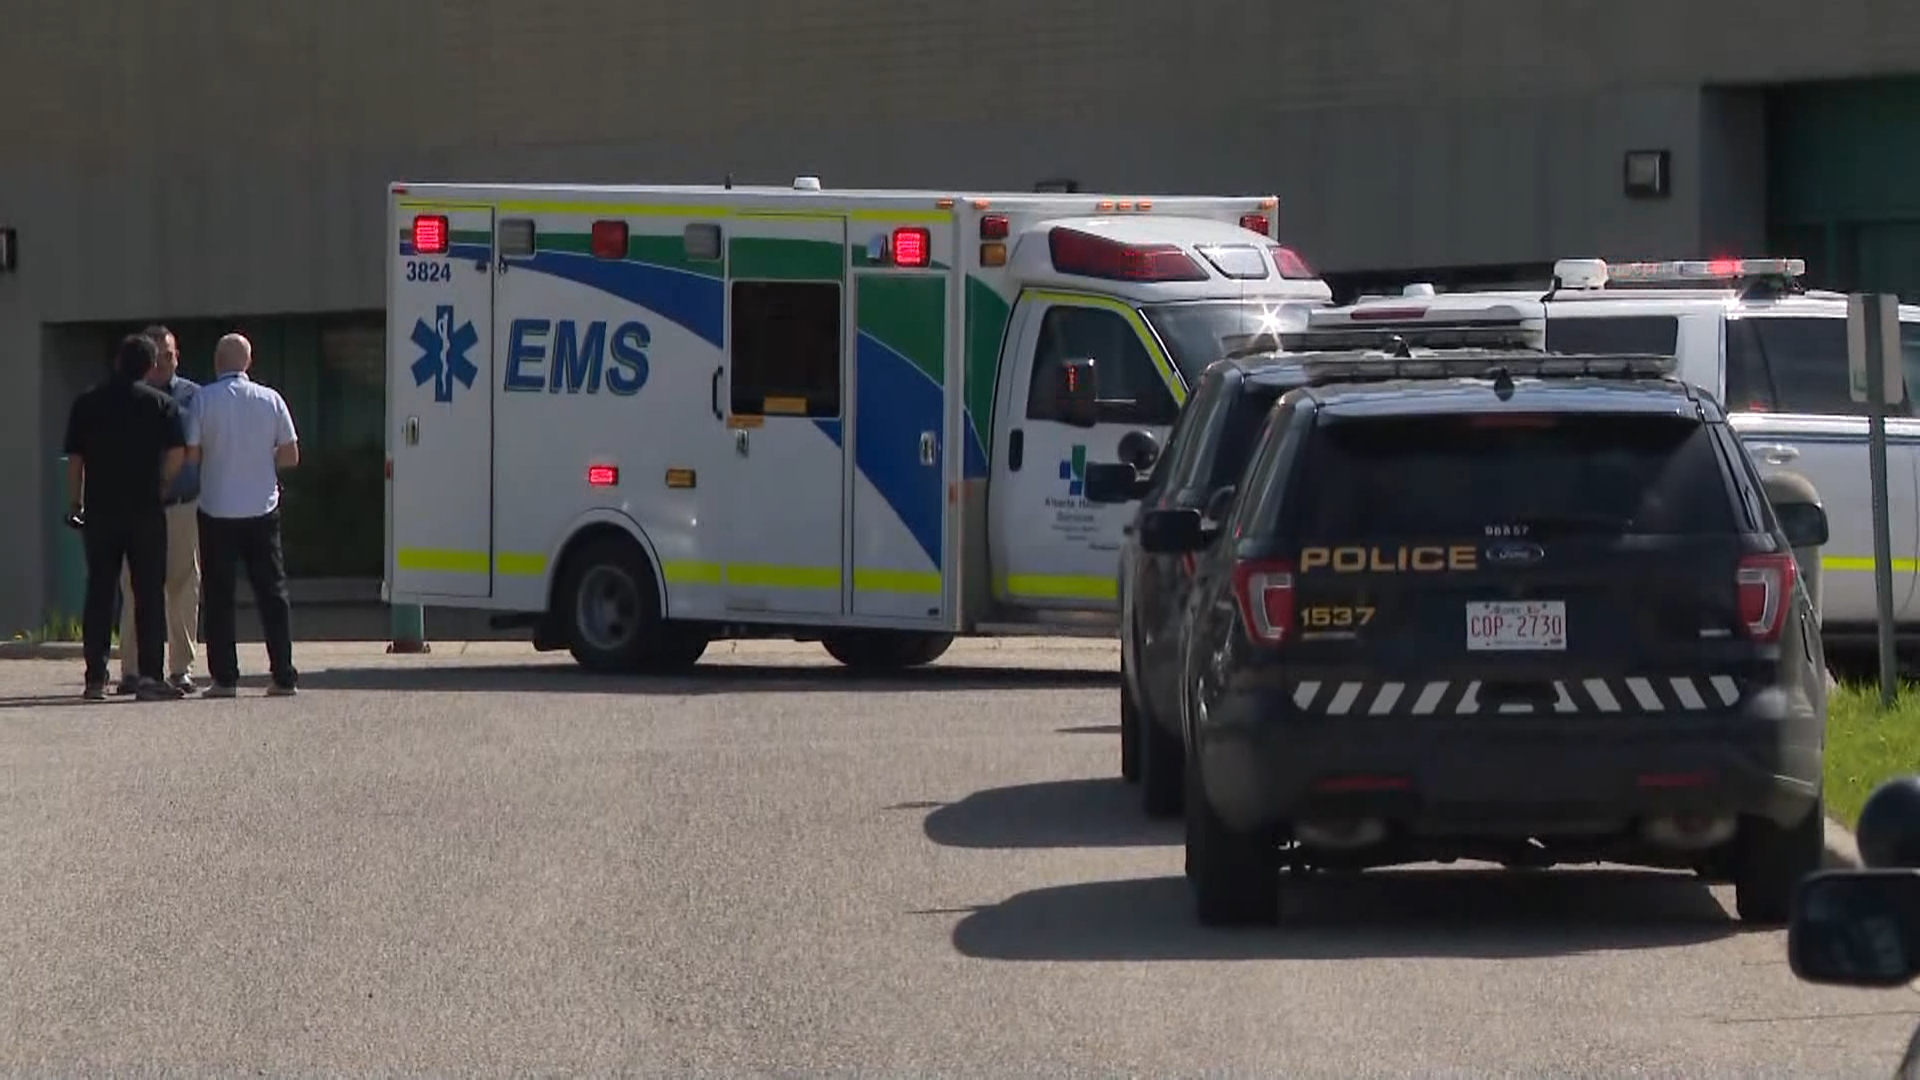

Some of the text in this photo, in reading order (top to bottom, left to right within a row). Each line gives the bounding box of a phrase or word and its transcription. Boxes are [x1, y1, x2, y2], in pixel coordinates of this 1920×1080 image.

[406, 260, 451, 282] 3824
[504, 318, 651, 396] EMS
[1300, 546, 1477, 572] POLICE
[1302, 606, 1376, 627] 1537
